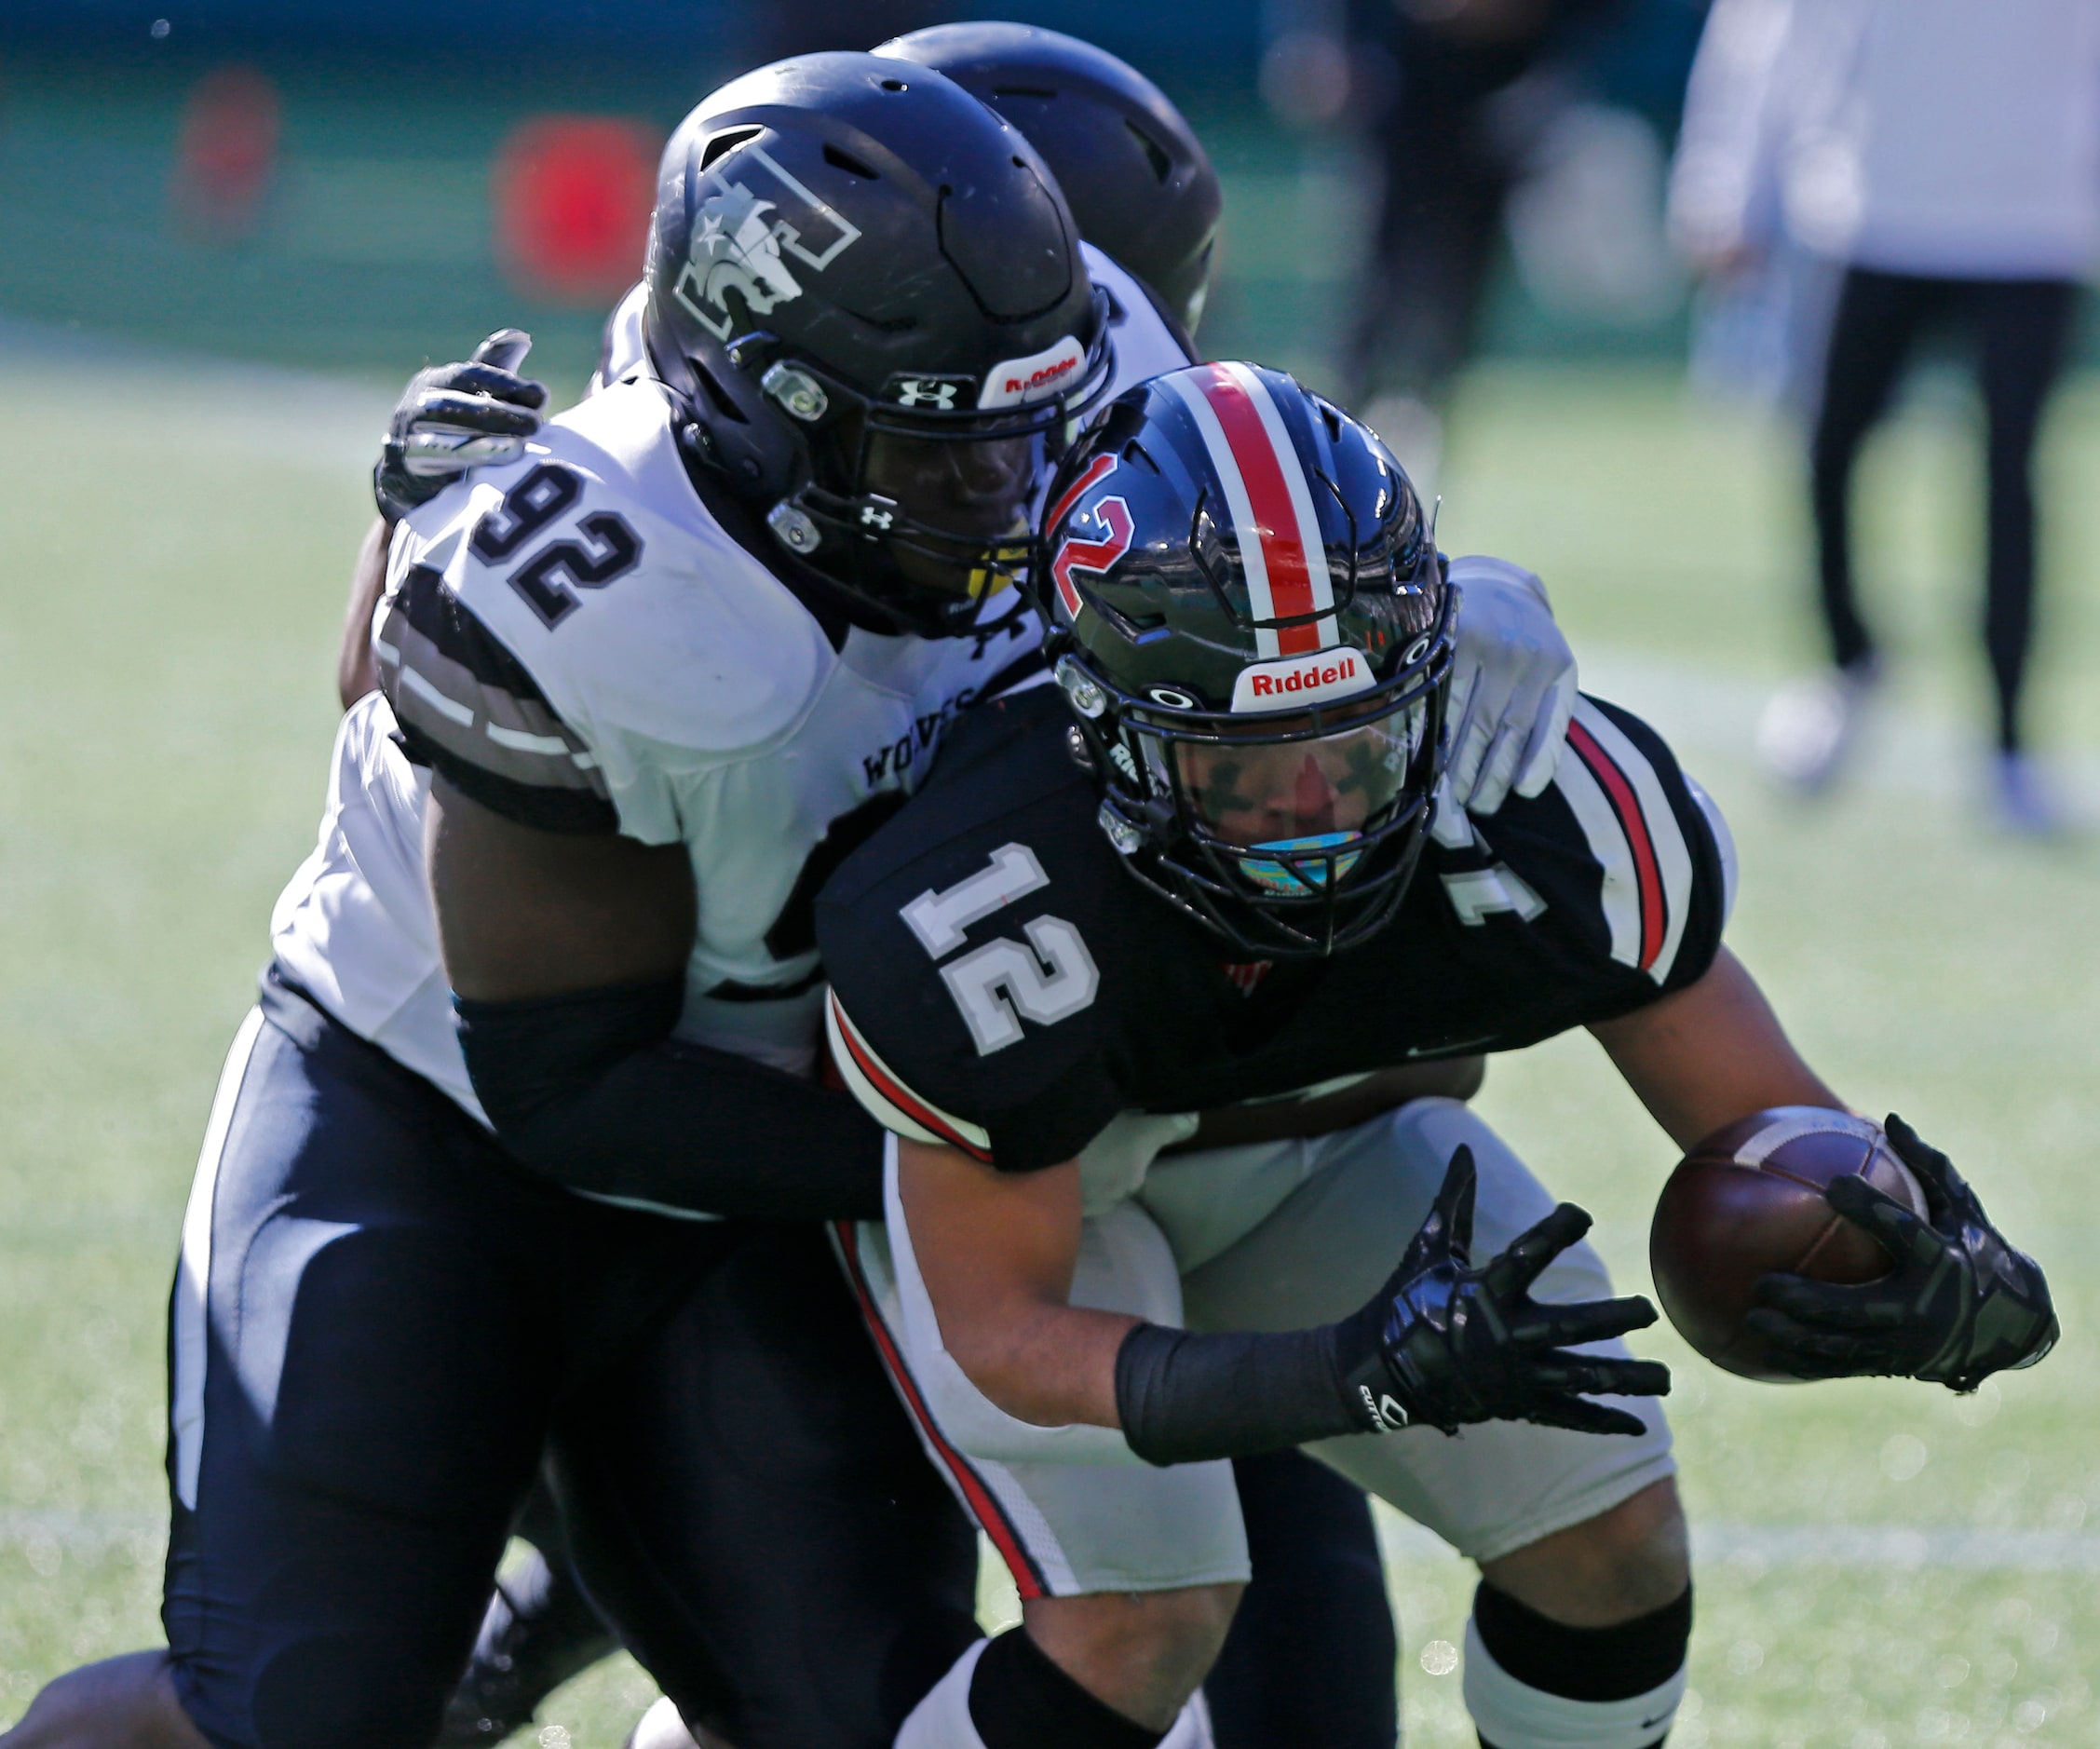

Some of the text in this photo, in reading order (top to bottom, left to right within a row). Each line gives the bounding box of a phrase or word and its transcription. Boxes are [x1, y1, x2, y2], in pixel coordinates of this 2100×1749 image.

[467, 462, 646, 633] 92
[1252, 658, 1356, 697] Riddell
[899, 841, 1101, 1058] 12
